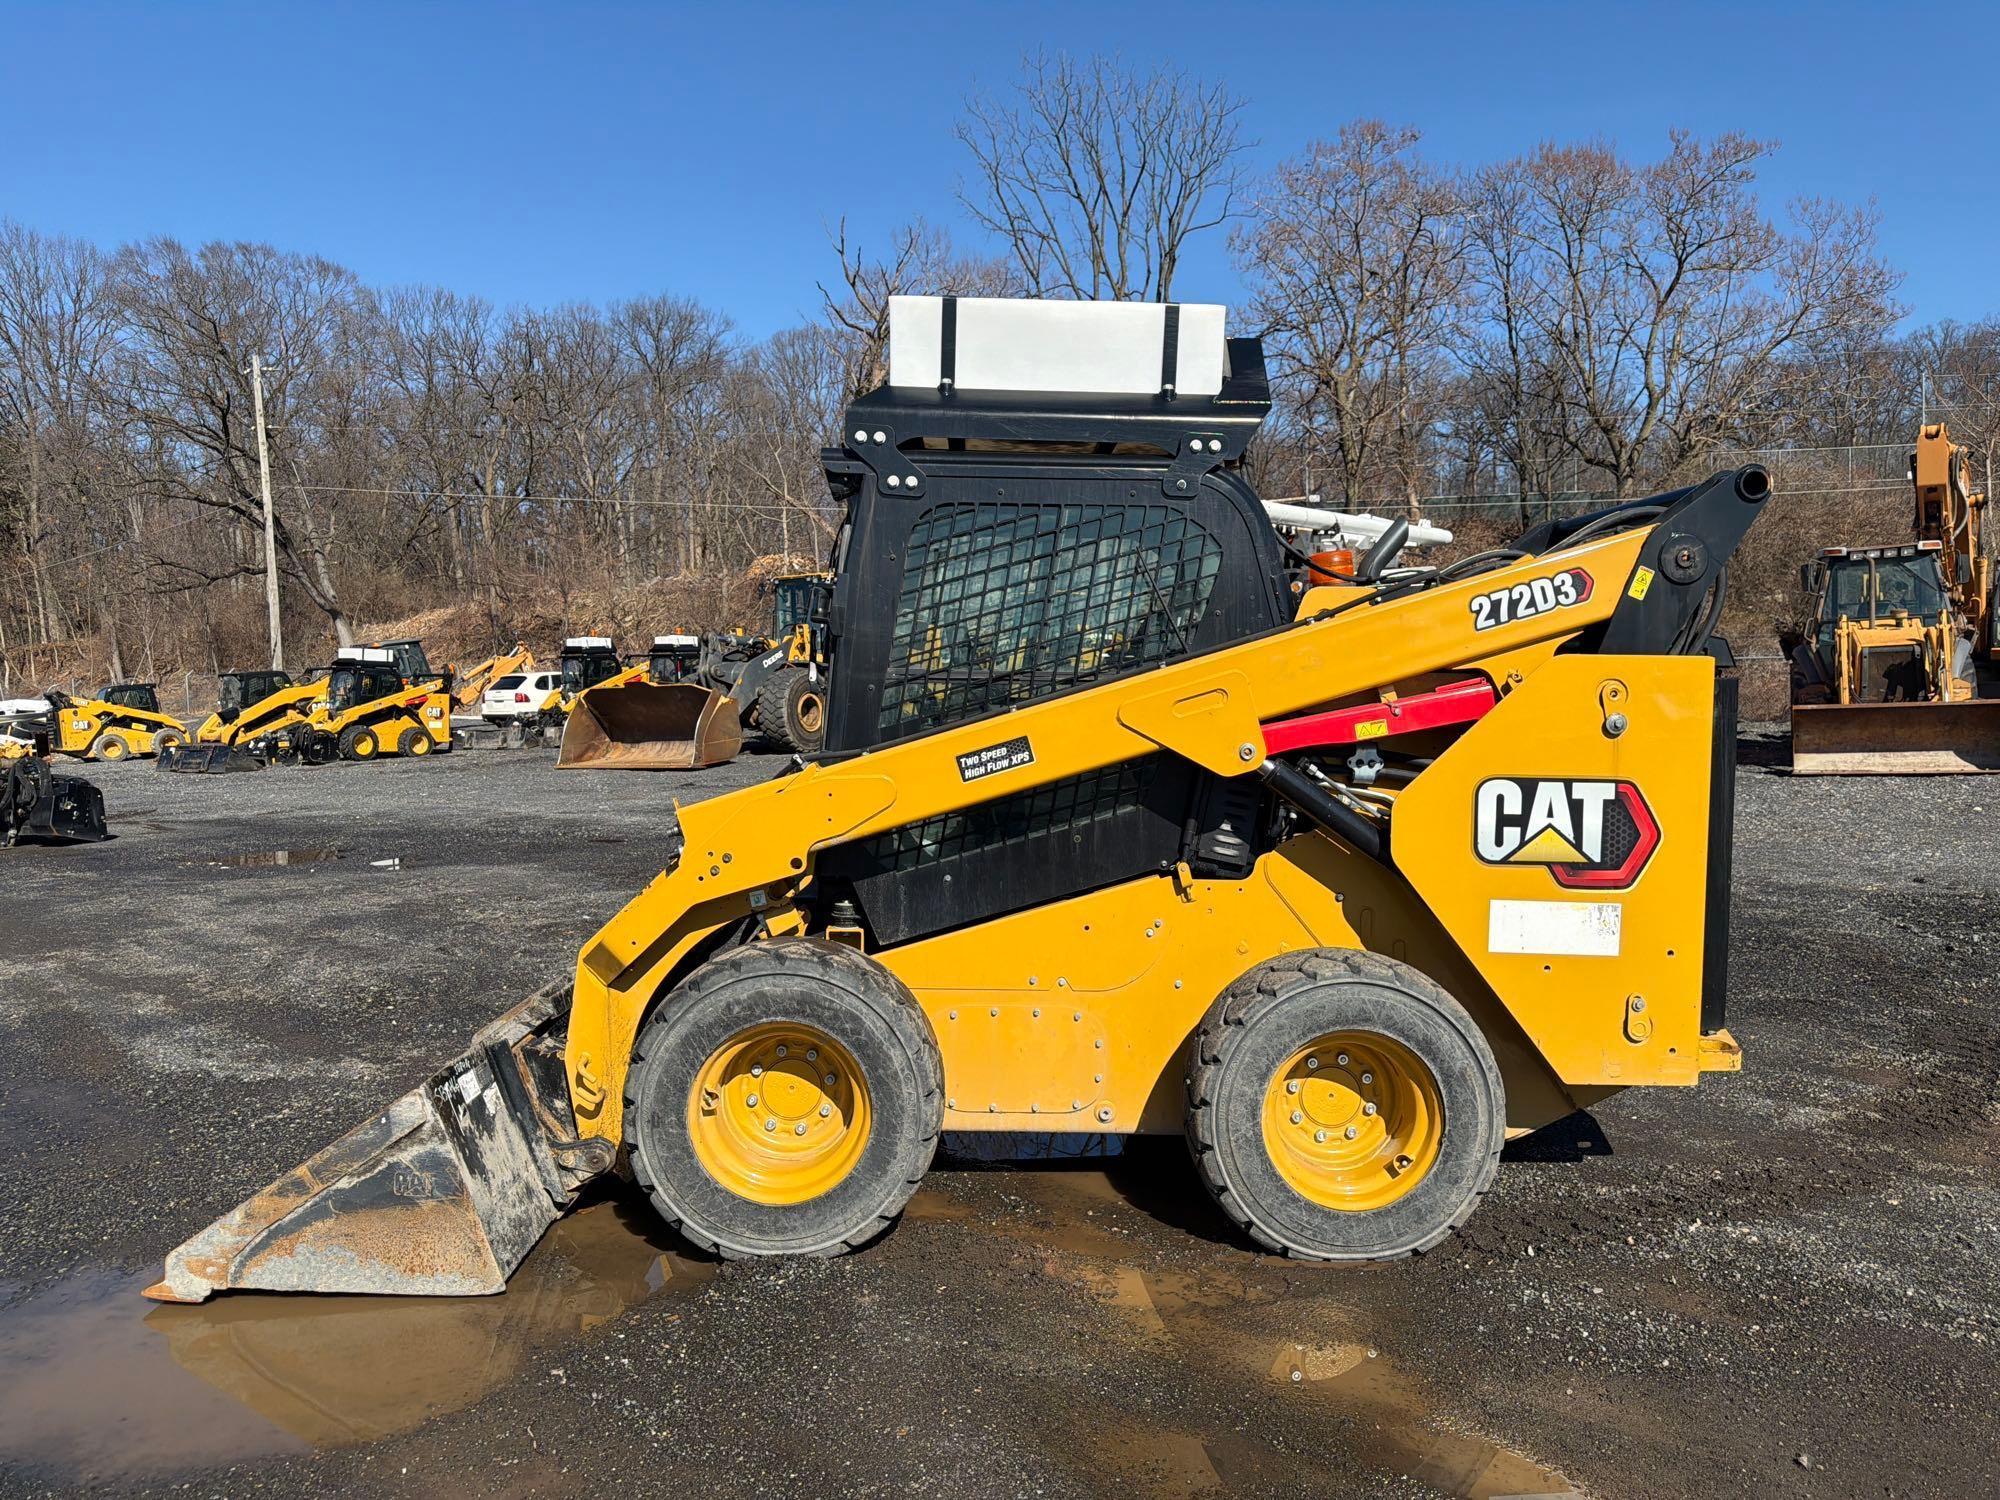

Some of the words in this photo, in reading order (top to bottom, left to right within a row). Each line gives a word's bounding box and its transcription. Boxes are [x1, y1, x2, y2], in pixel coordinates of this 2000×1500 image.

[1470, 572, 1577, 630] 272D3
[762, 650, 784, 668] DEERE
[427, 706, 442, 718] CAT
[72, 720, 89, 730] CAT
[1010, 751, 1030, 766] XPS
[1476, 778, 1616, 864] CAT
